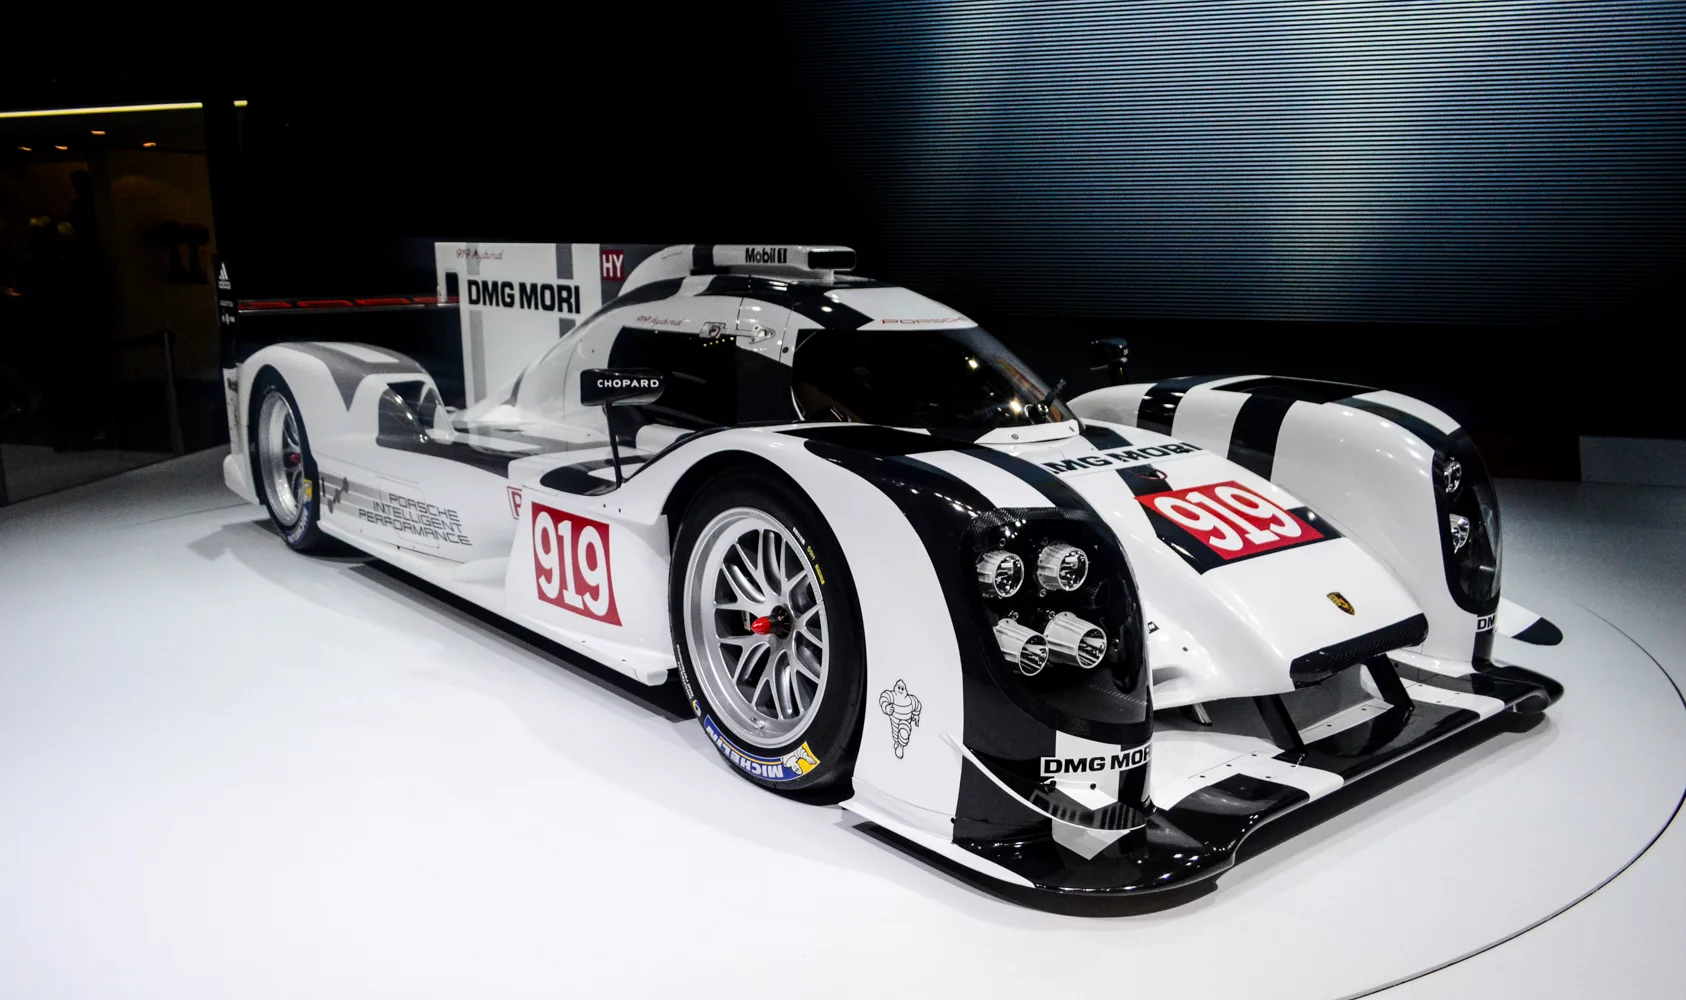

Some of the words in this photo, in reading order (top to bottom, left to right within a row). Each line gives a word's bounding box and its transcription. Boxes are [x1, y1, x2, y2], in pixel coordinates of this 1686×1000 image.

[456, 248, 471, 260] 919
[603, 253, 624, 278] HY
[745, 247, 776, 264] Mobil
[467, 279, 515, 309] DMG
[519, 282, 581, 315] MORI
[597, 379, 660, 388] CHOPARD
[1043, 455, 1113, 475] MG
[373, 502, 463, 534] INTELLIGENT
[388, 493, 461, 522] PORSCHE
[1153, 485, 1302, 551] 919
[358, 508, 473, 546] PERFORMANCE
[534, 510, 610, 617] 919
[1477, 613, 1496, 630] DM
[706, 725, 784, 779] MICHELIN
[1043, 756, 1106, 774] DMG
[1110, 745, 1151, 770] MOR
